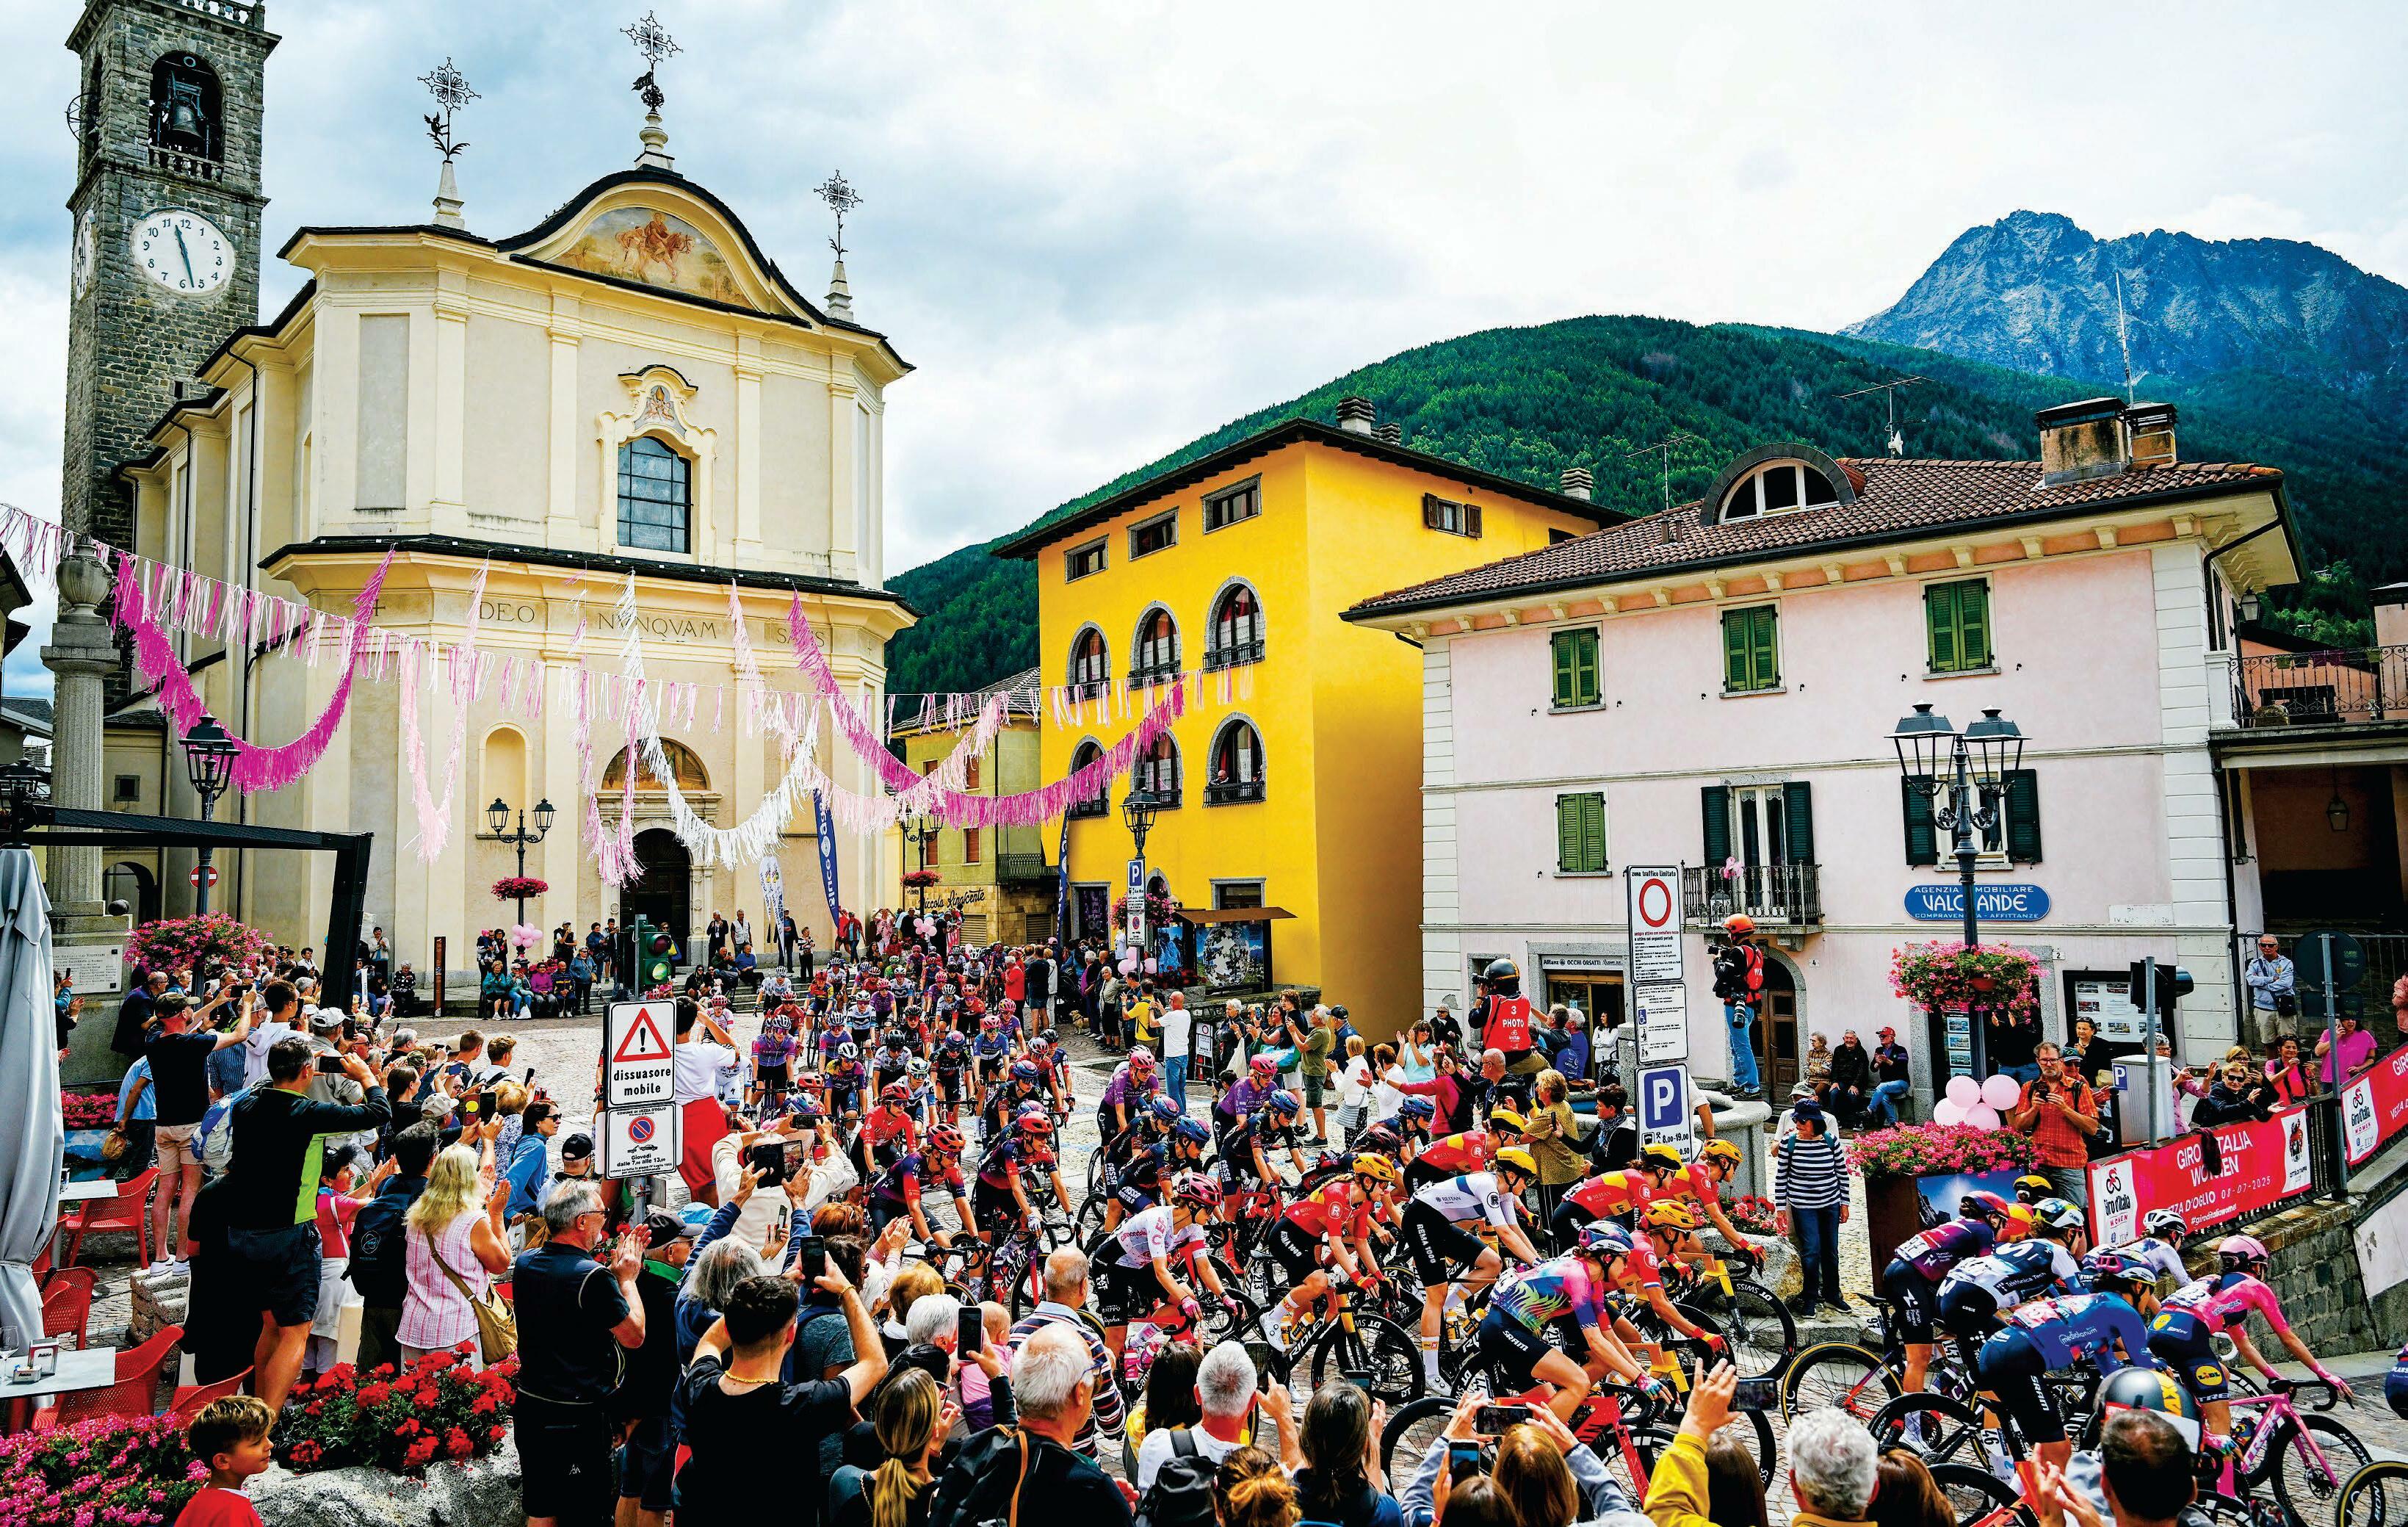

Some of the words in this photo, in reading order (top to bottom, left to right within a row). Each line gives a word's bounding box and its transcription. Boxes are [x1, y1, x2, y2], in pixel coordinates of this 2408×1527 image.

[162, 218, 170, 228] 11
[181, 219, 191, 229] 12
[148, 227, 159, 237] 10
[200, 228, 204, 236] 1
[143, 241, 150, 250] 9
[213, 241, 220, 250] 2
[148, 259, 154, 267] 8
[216, 256, 222, 266] 3
[162, 272, 168, 281] 7
[179, 279, 187, 288] 6
[198, 279, 204, 288] 5
[211, 272, 219, 281] 4
[479, 602, 535, 624] DEO
[777, 628, 825, 648] SAS
[1132, 865, 1140, 883] P
[1923, 895, 2028, 911] VALGANDE
[1511, 1006, 1517, 1015] 3
[1503, 1019, 1525, 1028] PHOTO
[614, 1068, 671, 1081] dissuasore
[2115, 1066, 2126, 1086] P
[624, 1083, 661, 1096] mobile
[1652, 1078, 1674, 1121] P
[1663, 1133, 1689, 1144] 8.00-19.00
[2177, 1142, 2202, 1170] GIRO
[2213, 1130, 2253, 1152] TALIA
[1107, 1163, 1118, 1185] FASSA
[1221, 1159, 1232, 1182] FASSA
[2191, 1155, 2239, 1187] WOEN
[1122, 1185, 1141, 1199] FASSA
[1179, 1184, 1190, 1194] EF
[2185, 1191, 2216, 1213] D'OGLIO
[2221, 1177, 2271, 1199] 08-07-2025
[1118, 1191, 1135, 1205] BORTOLO
[1287, 1243, 1303, 1257] 1000
[1416, 1224, 1429, 1246] REMA
[1425, 1243, 1436, 1264] 1000
[999, 1249, 1028, 1293] FACTOR
[1253, 1274, 1263, 1290] 213
[2005, 1275, 2033, 1287] Telefónica
[2033, 1271, 2046, 1281] Tech
[1736, 1282, 1760, 1294] SWISS
[1758, 1291, 1773, 1302] DT
[1289, 1317, 1324, 1362] RIDLEY
[1503, 1330, 1529, 1351] SRAM
[1548, 1327, 1561, 1347] 217
[2062, 1326, 2097, 1343] mediolanum
[1473, 1378, 1487, 1391] 44
[2031, 1375, 2049, 1411] SRAM
[1984, 1429, 2000, 1445] 46
